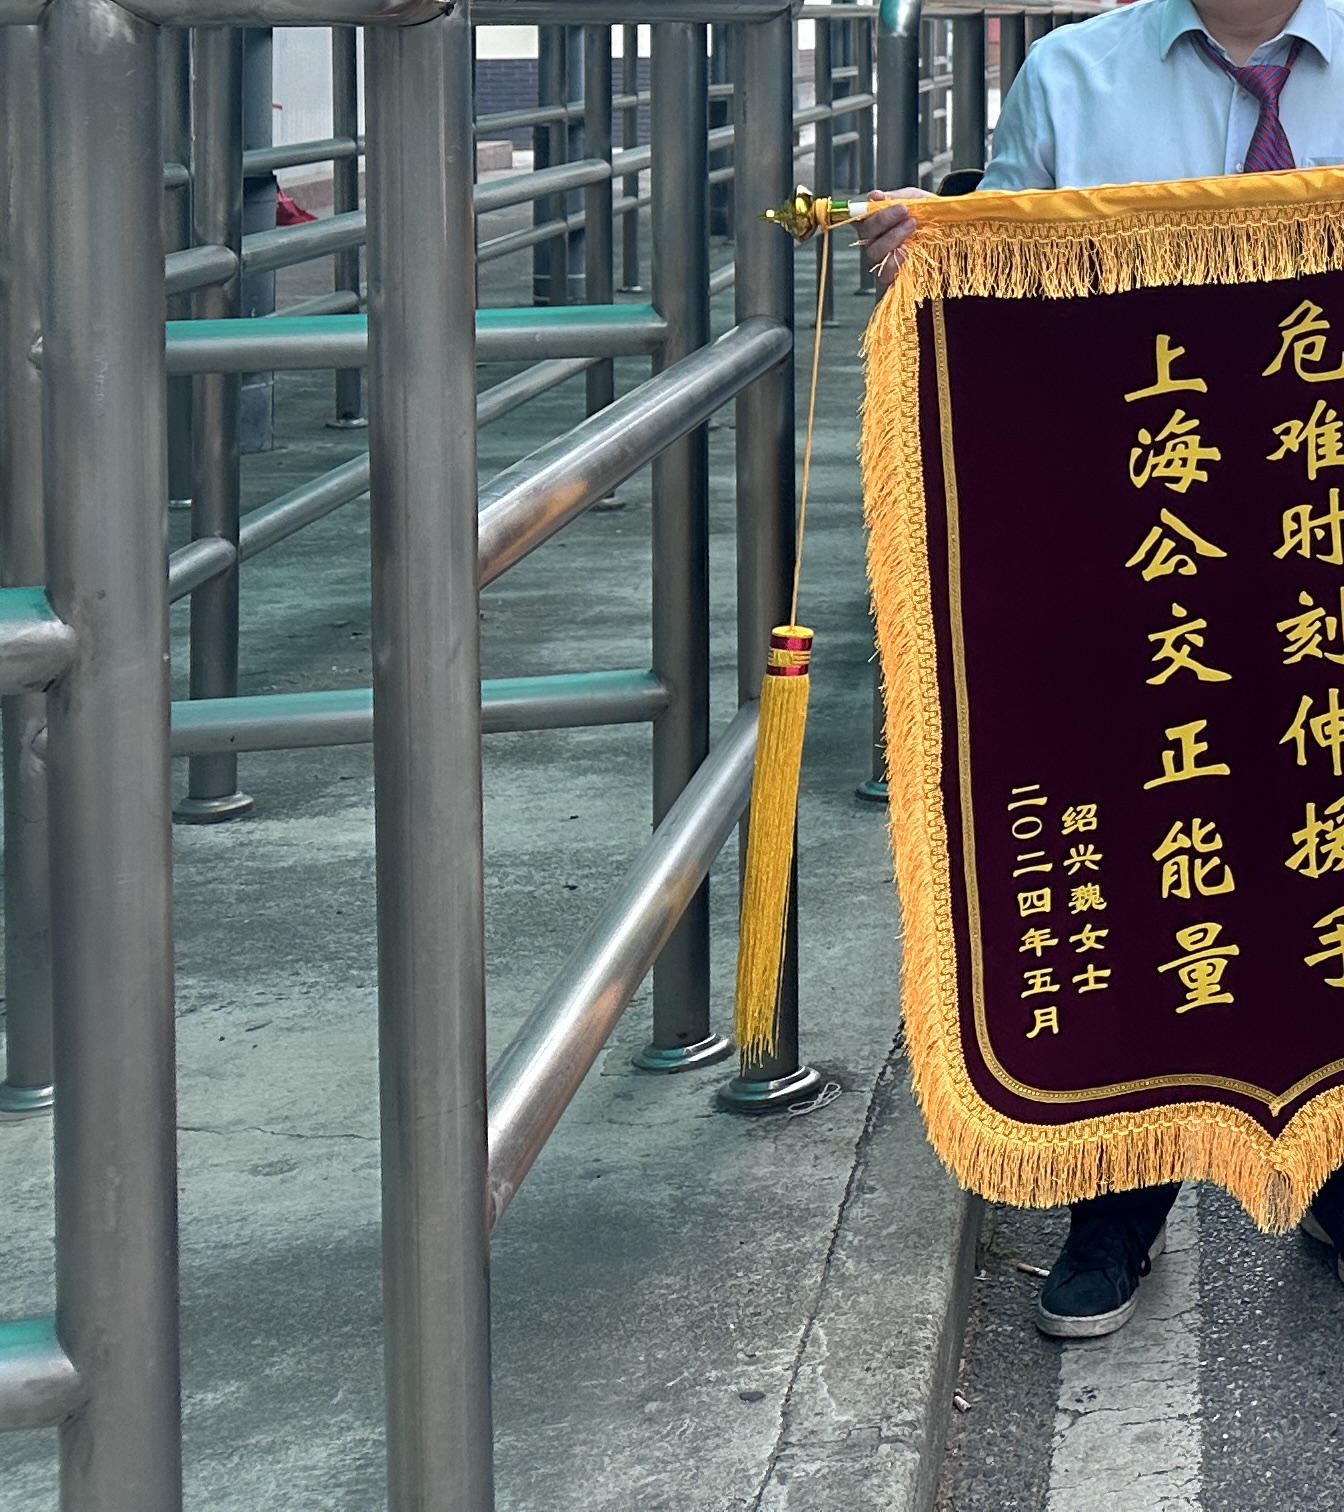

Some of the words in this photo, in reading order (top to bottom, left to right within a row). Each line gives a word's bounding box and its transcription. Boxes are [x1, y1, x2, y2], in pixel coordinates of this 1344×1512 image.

[1124, 334, 1240, 1015] 上海公交正能量
[1061, 803, 1112, 994] 绍兴魏女士
